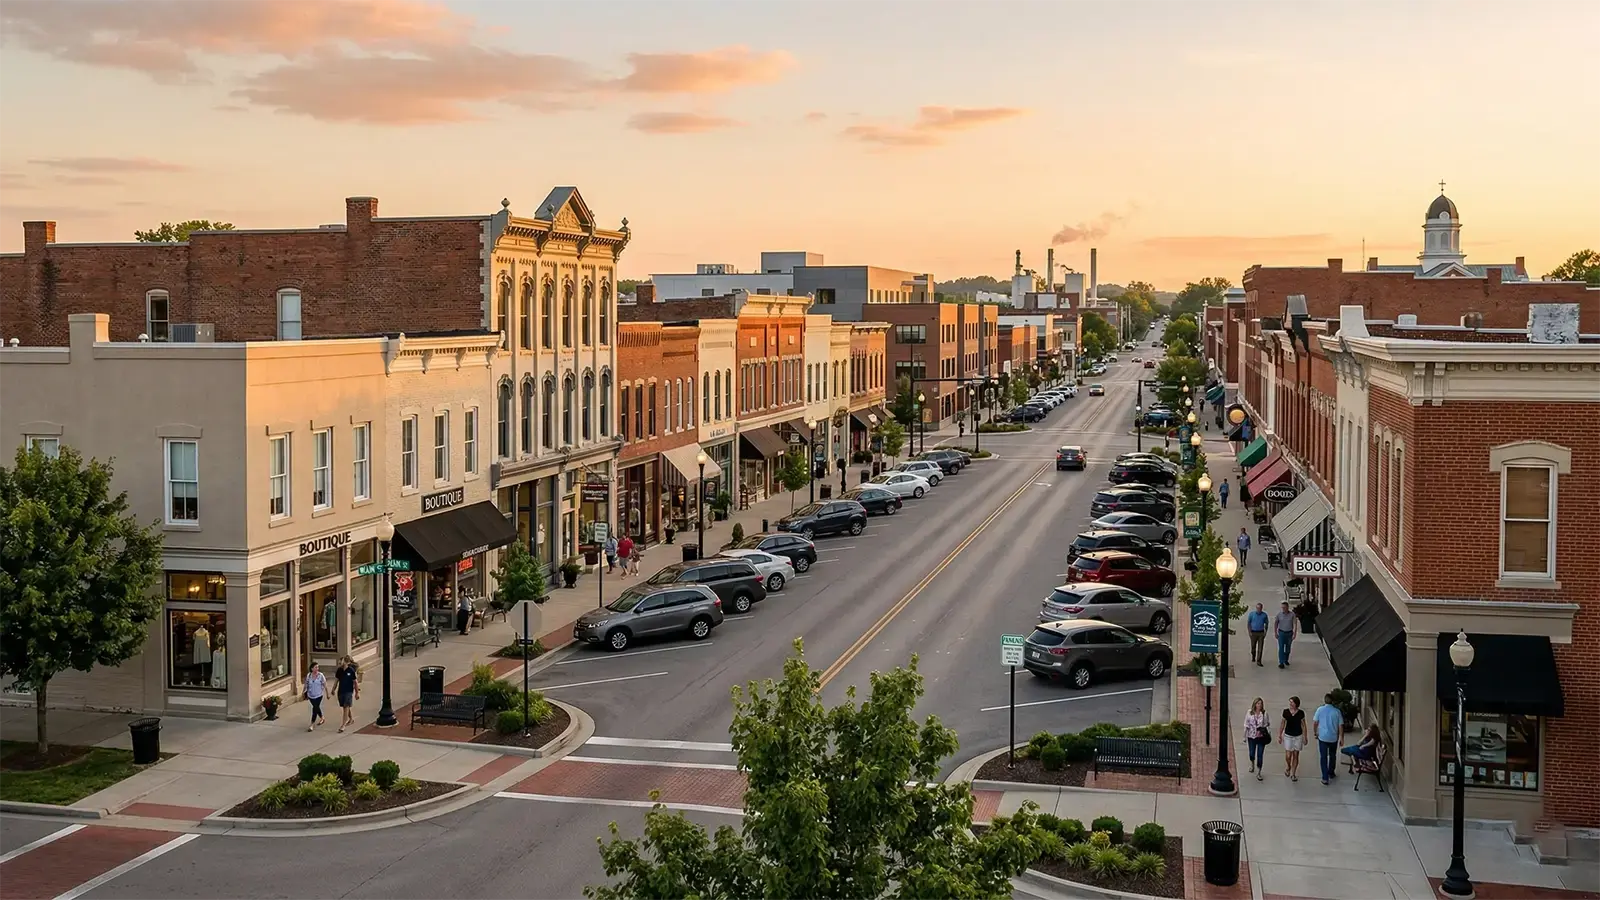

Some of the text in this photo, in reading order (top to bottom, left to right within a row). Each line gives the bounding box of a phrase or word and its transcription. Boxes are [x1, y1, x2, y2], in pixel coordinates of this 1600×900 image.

[425, 490, 463, 510] BOUTIQUE
[299, 531, 352, 556] BOUTIQUE
[1296, 561, 1338, 572] BOOKS
